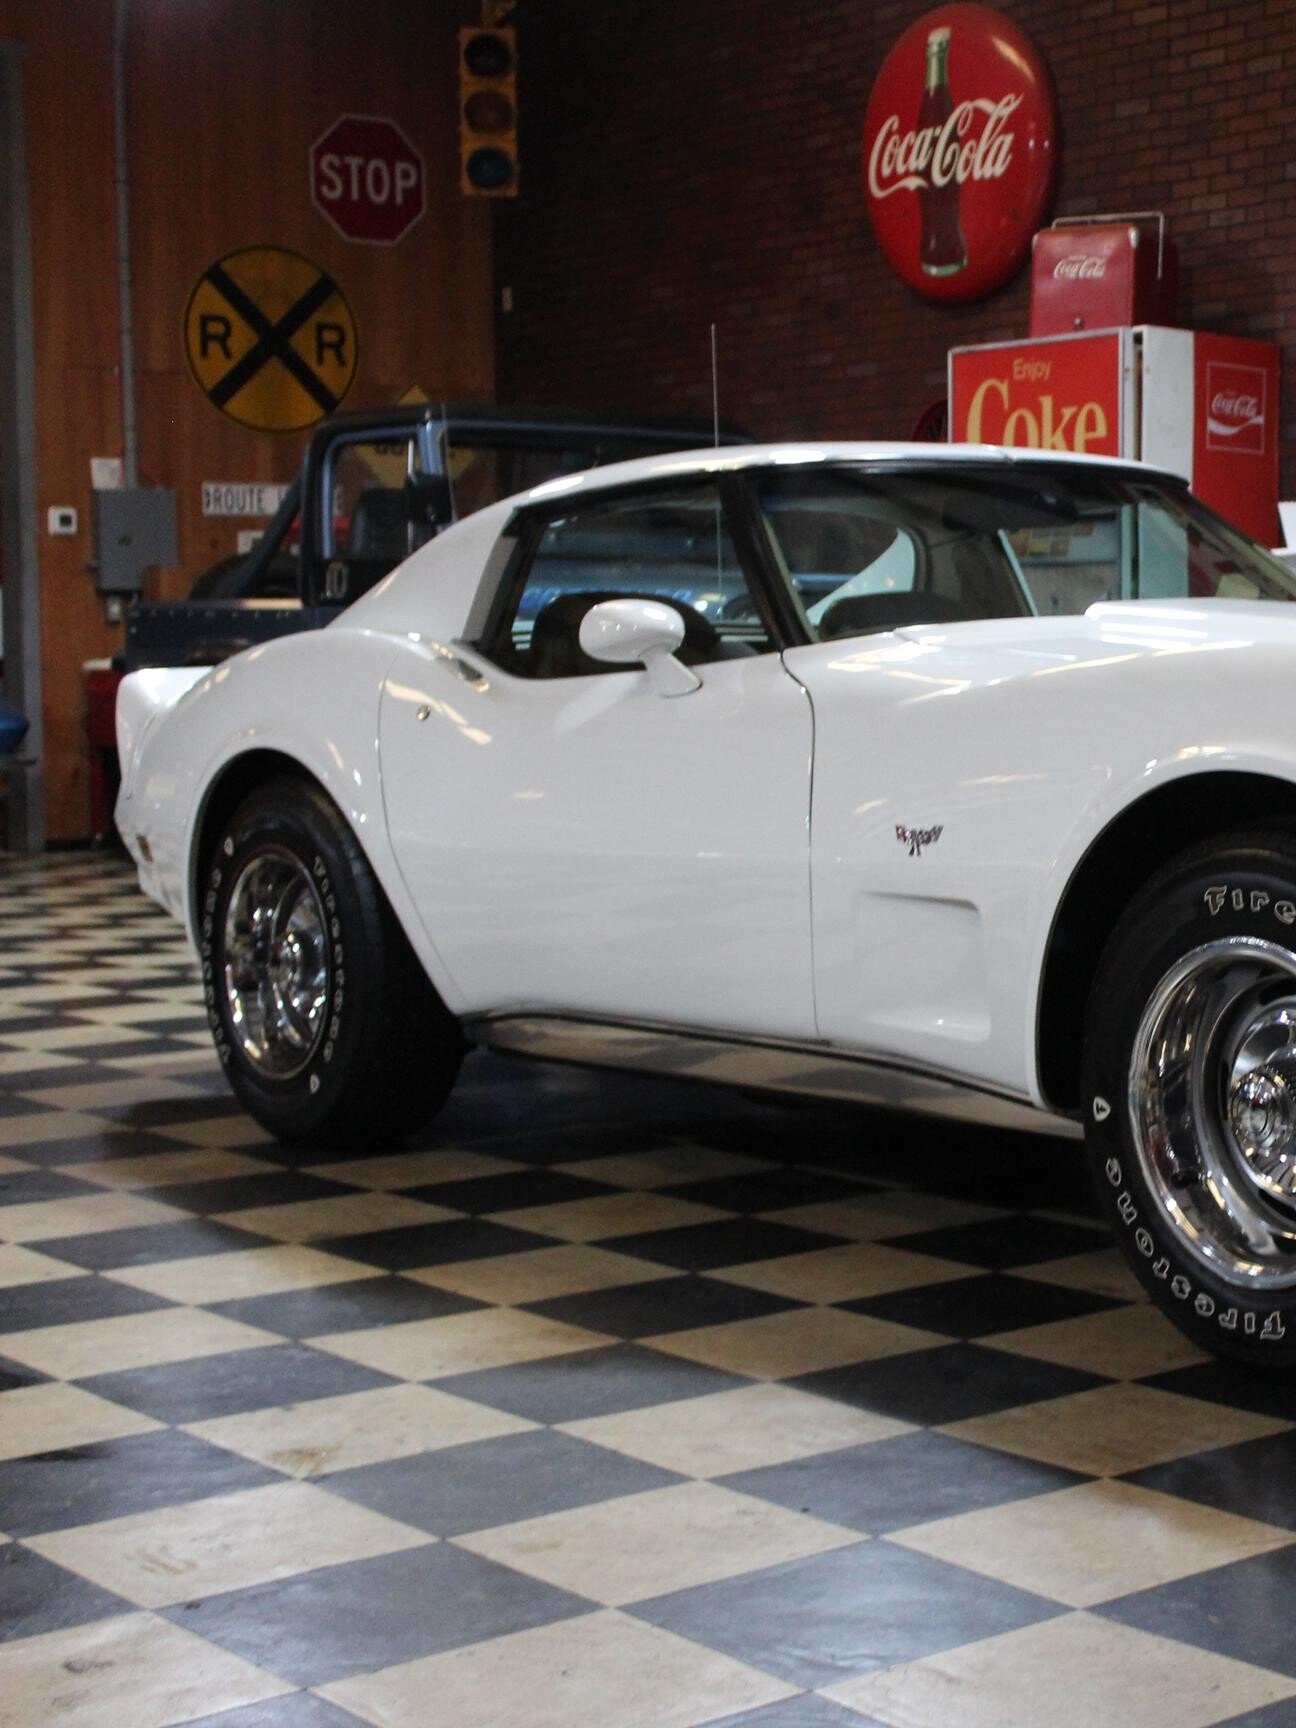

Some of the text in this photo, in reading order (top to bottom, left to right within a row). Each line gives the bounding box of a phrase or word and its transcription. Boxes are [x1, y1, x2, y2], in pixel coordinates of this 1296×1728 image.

[868, 94, 1022, 198] Coca-Cola
[319, 154, 419, 203] STOP
[200, 314, 347, 367] R R
[1012, 358, 1052, 382] Enjoy
[967, 379, 1108, 456] Coke
[215, 485, 265, 513] ROUTE
[1105, 1157, 1286, 1342] Firestone
